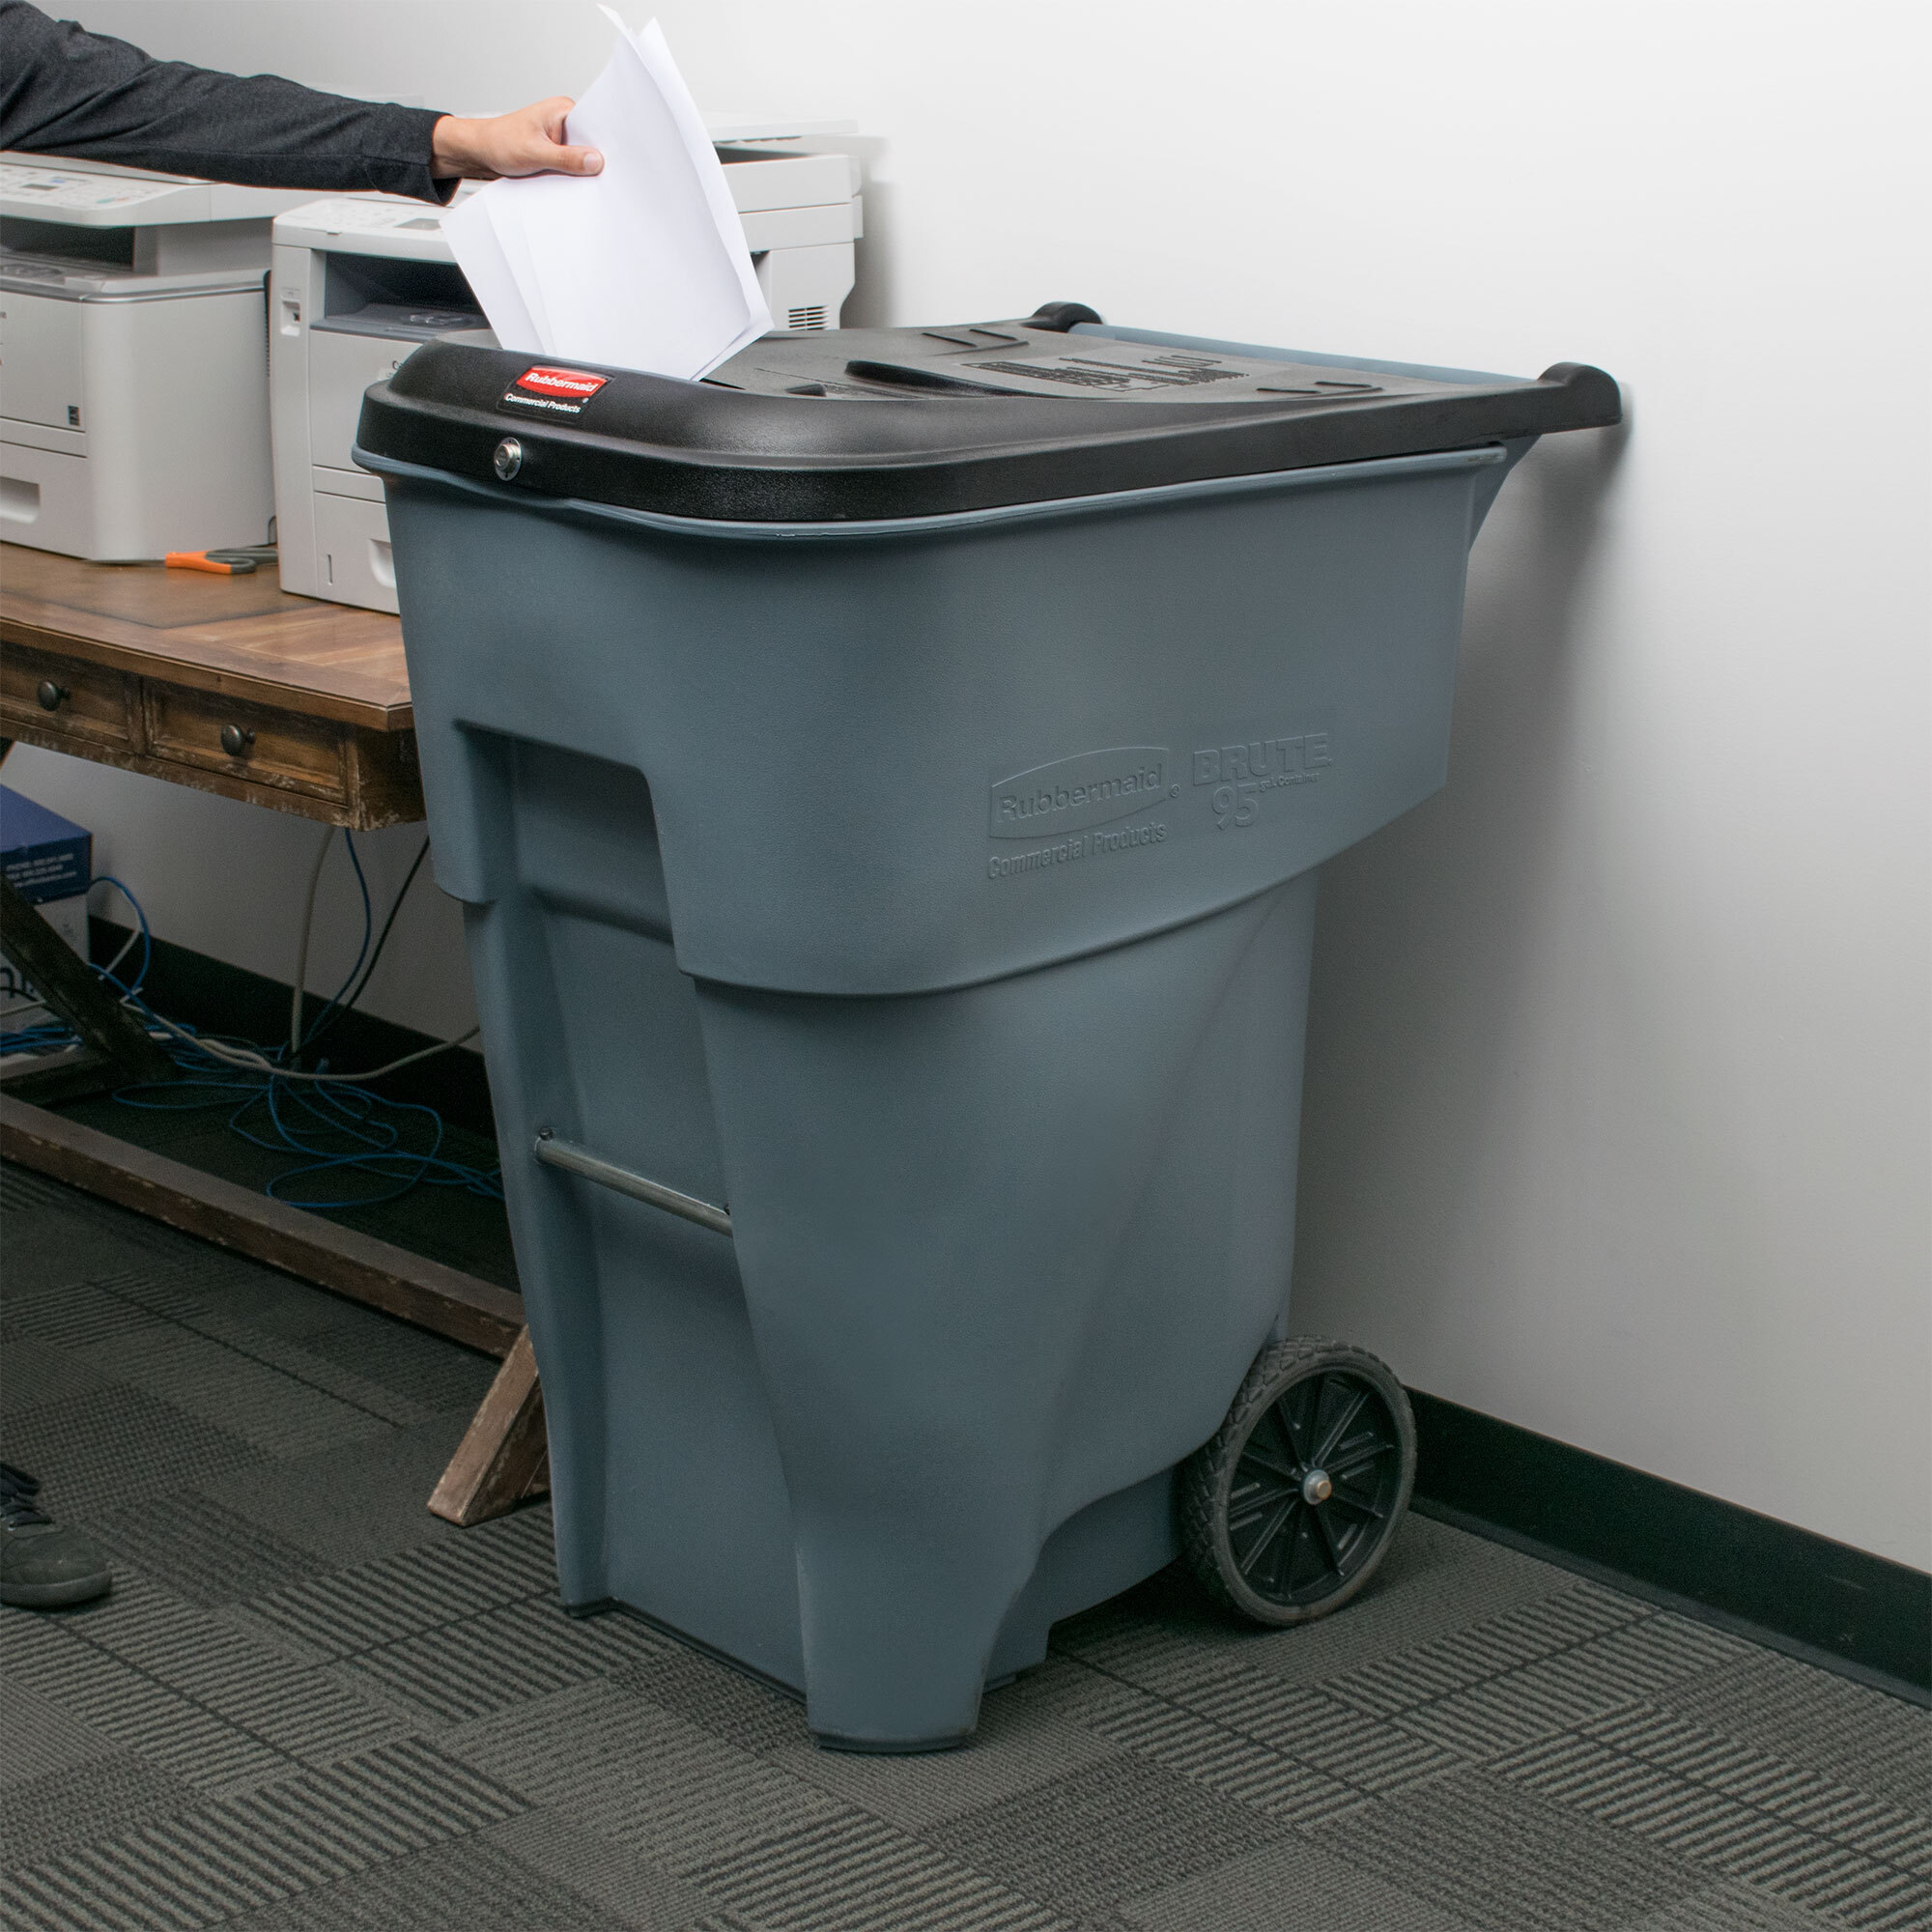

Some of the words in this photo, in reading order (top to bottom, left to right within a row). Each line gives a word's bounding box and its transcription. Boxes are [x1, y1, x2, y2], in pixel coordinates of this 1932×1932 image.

[504, 393, 549, 408] Commercial
[547, 401, 581, 413] Products
[525, 372, 598, 392] Rubbermaid
[1192, 732, 1330, 786] BRUTE
[997, 762, 1162, 823] Rubbermaid
[1211, 782, 1260, 831] 95
[988, 835, 1090, 880] Commercial
[1092, 821, 1167, 856] Products
